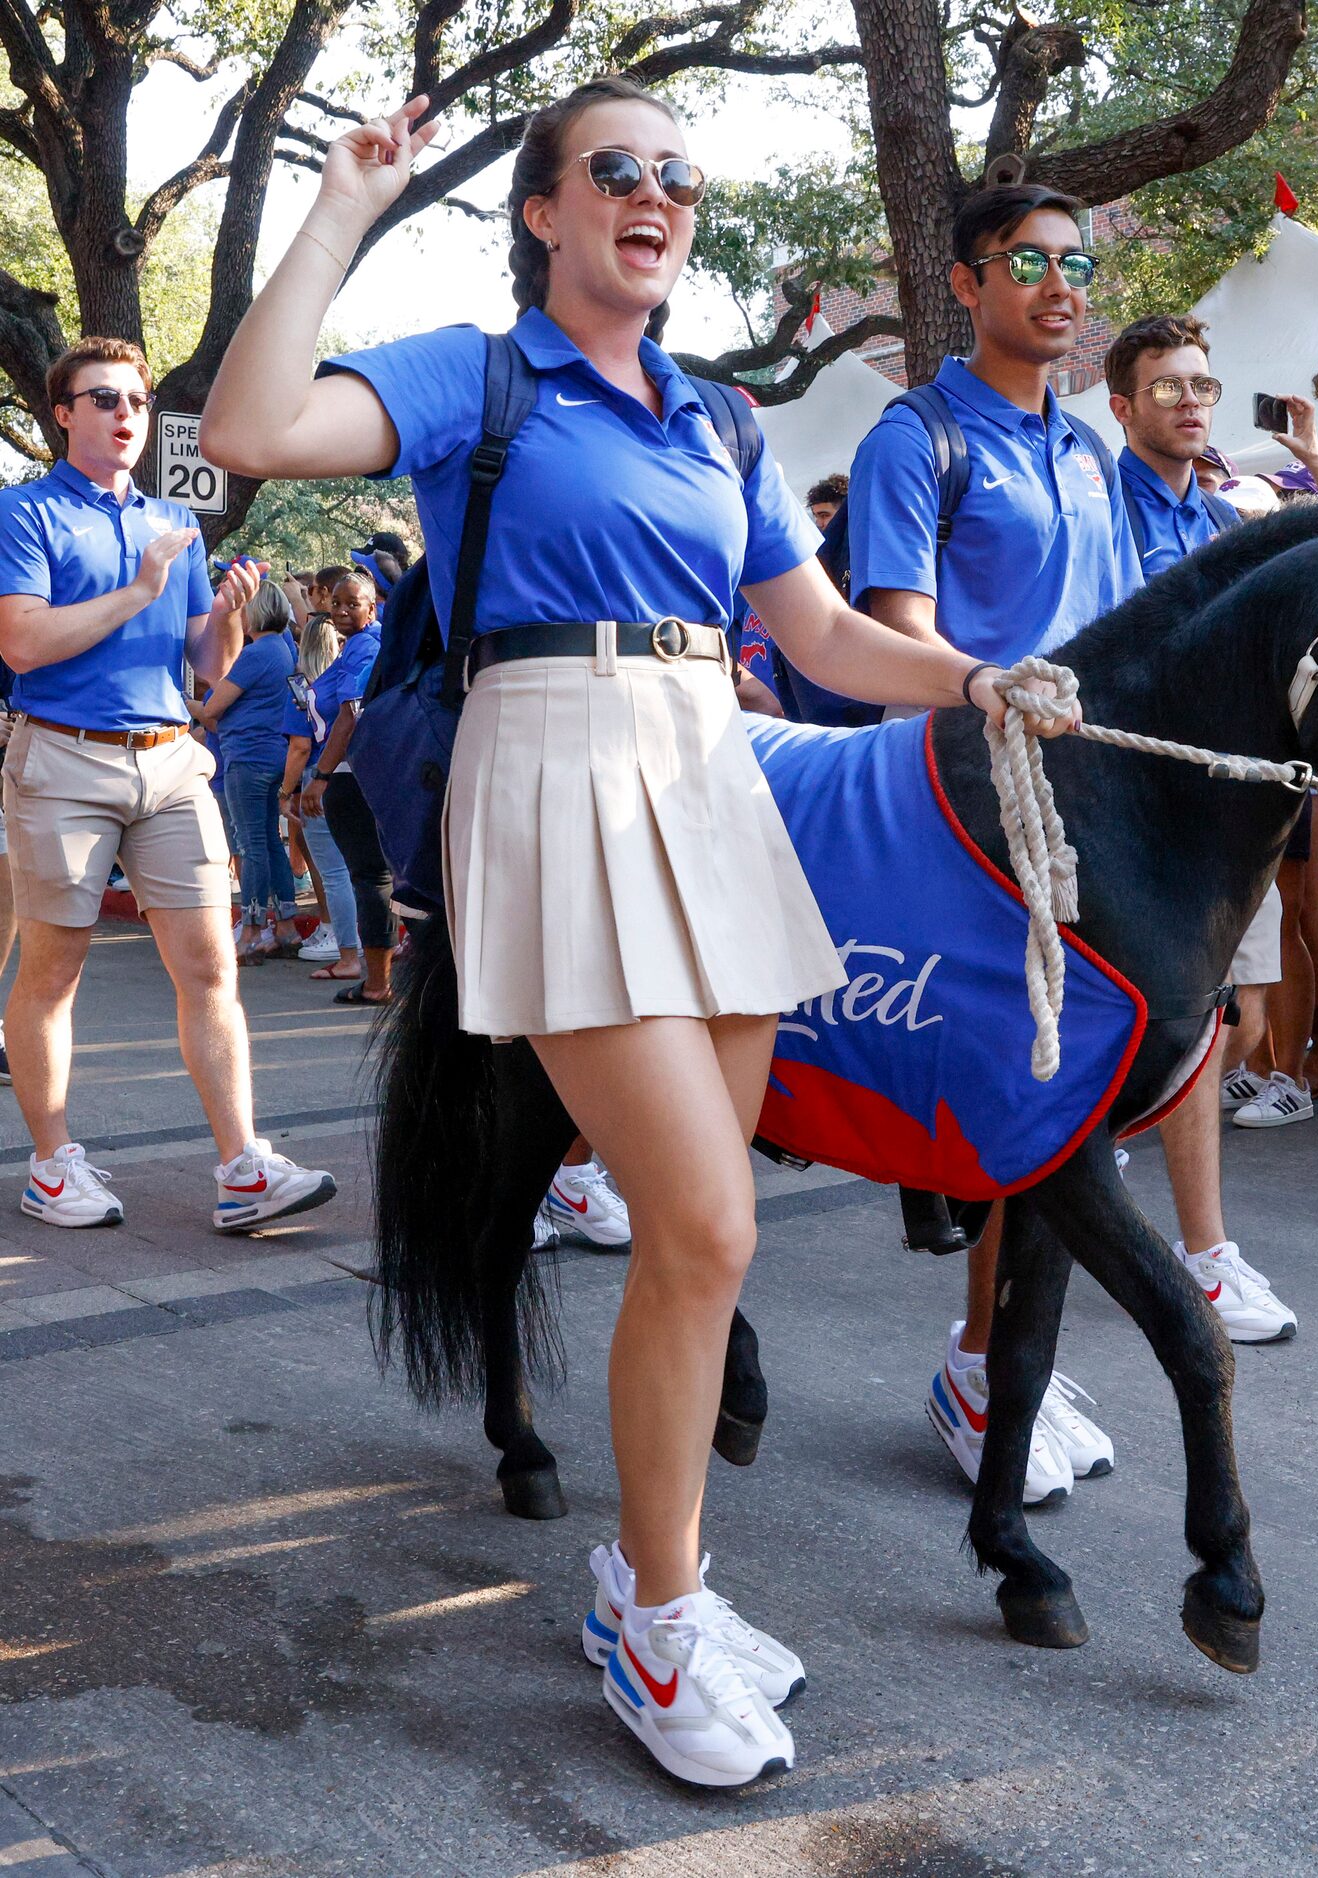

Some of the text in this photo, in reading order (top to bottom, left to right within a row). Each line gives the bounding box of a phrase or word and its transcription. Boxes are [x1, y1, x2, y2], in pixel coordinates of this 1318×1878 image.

[164, 424, 198, 440] SPE
[170, 442, 201, 458] LIM
[168, 463, 217, 501] 20
